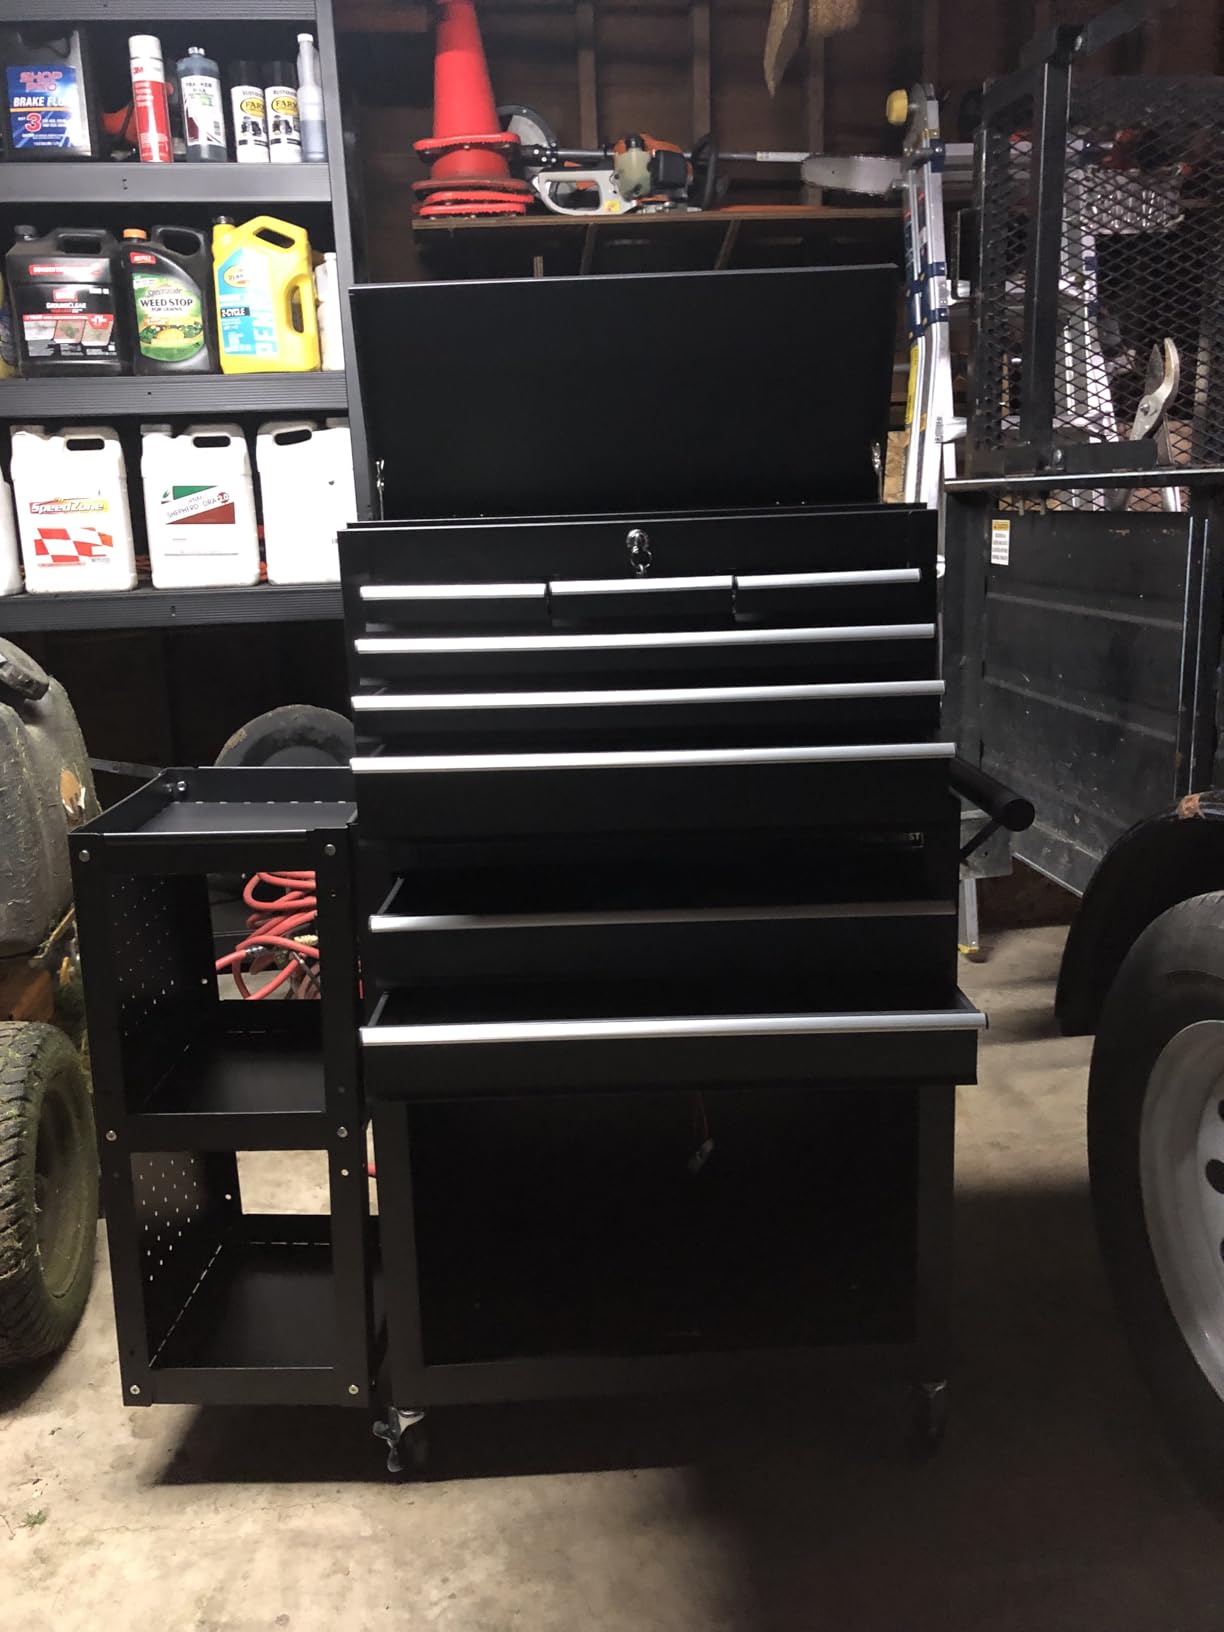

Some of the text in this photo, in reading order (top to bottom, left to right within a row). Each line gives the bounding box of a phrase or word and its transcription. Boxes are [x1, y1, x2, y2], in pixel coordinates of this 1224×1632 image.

[133, 66, 144, 74] 3M
[20, 71, 64, 83] SHOP
[13, 96, 45, 108] BRAKE
[245, 101, 265, 109] FAR
[24, 112, 42, 133] 3
[140, 299, 168, 307] WEED
[221, 307, 246, 317] 2-CYCLE
[31, 500, 105, 515] SpeedZone
